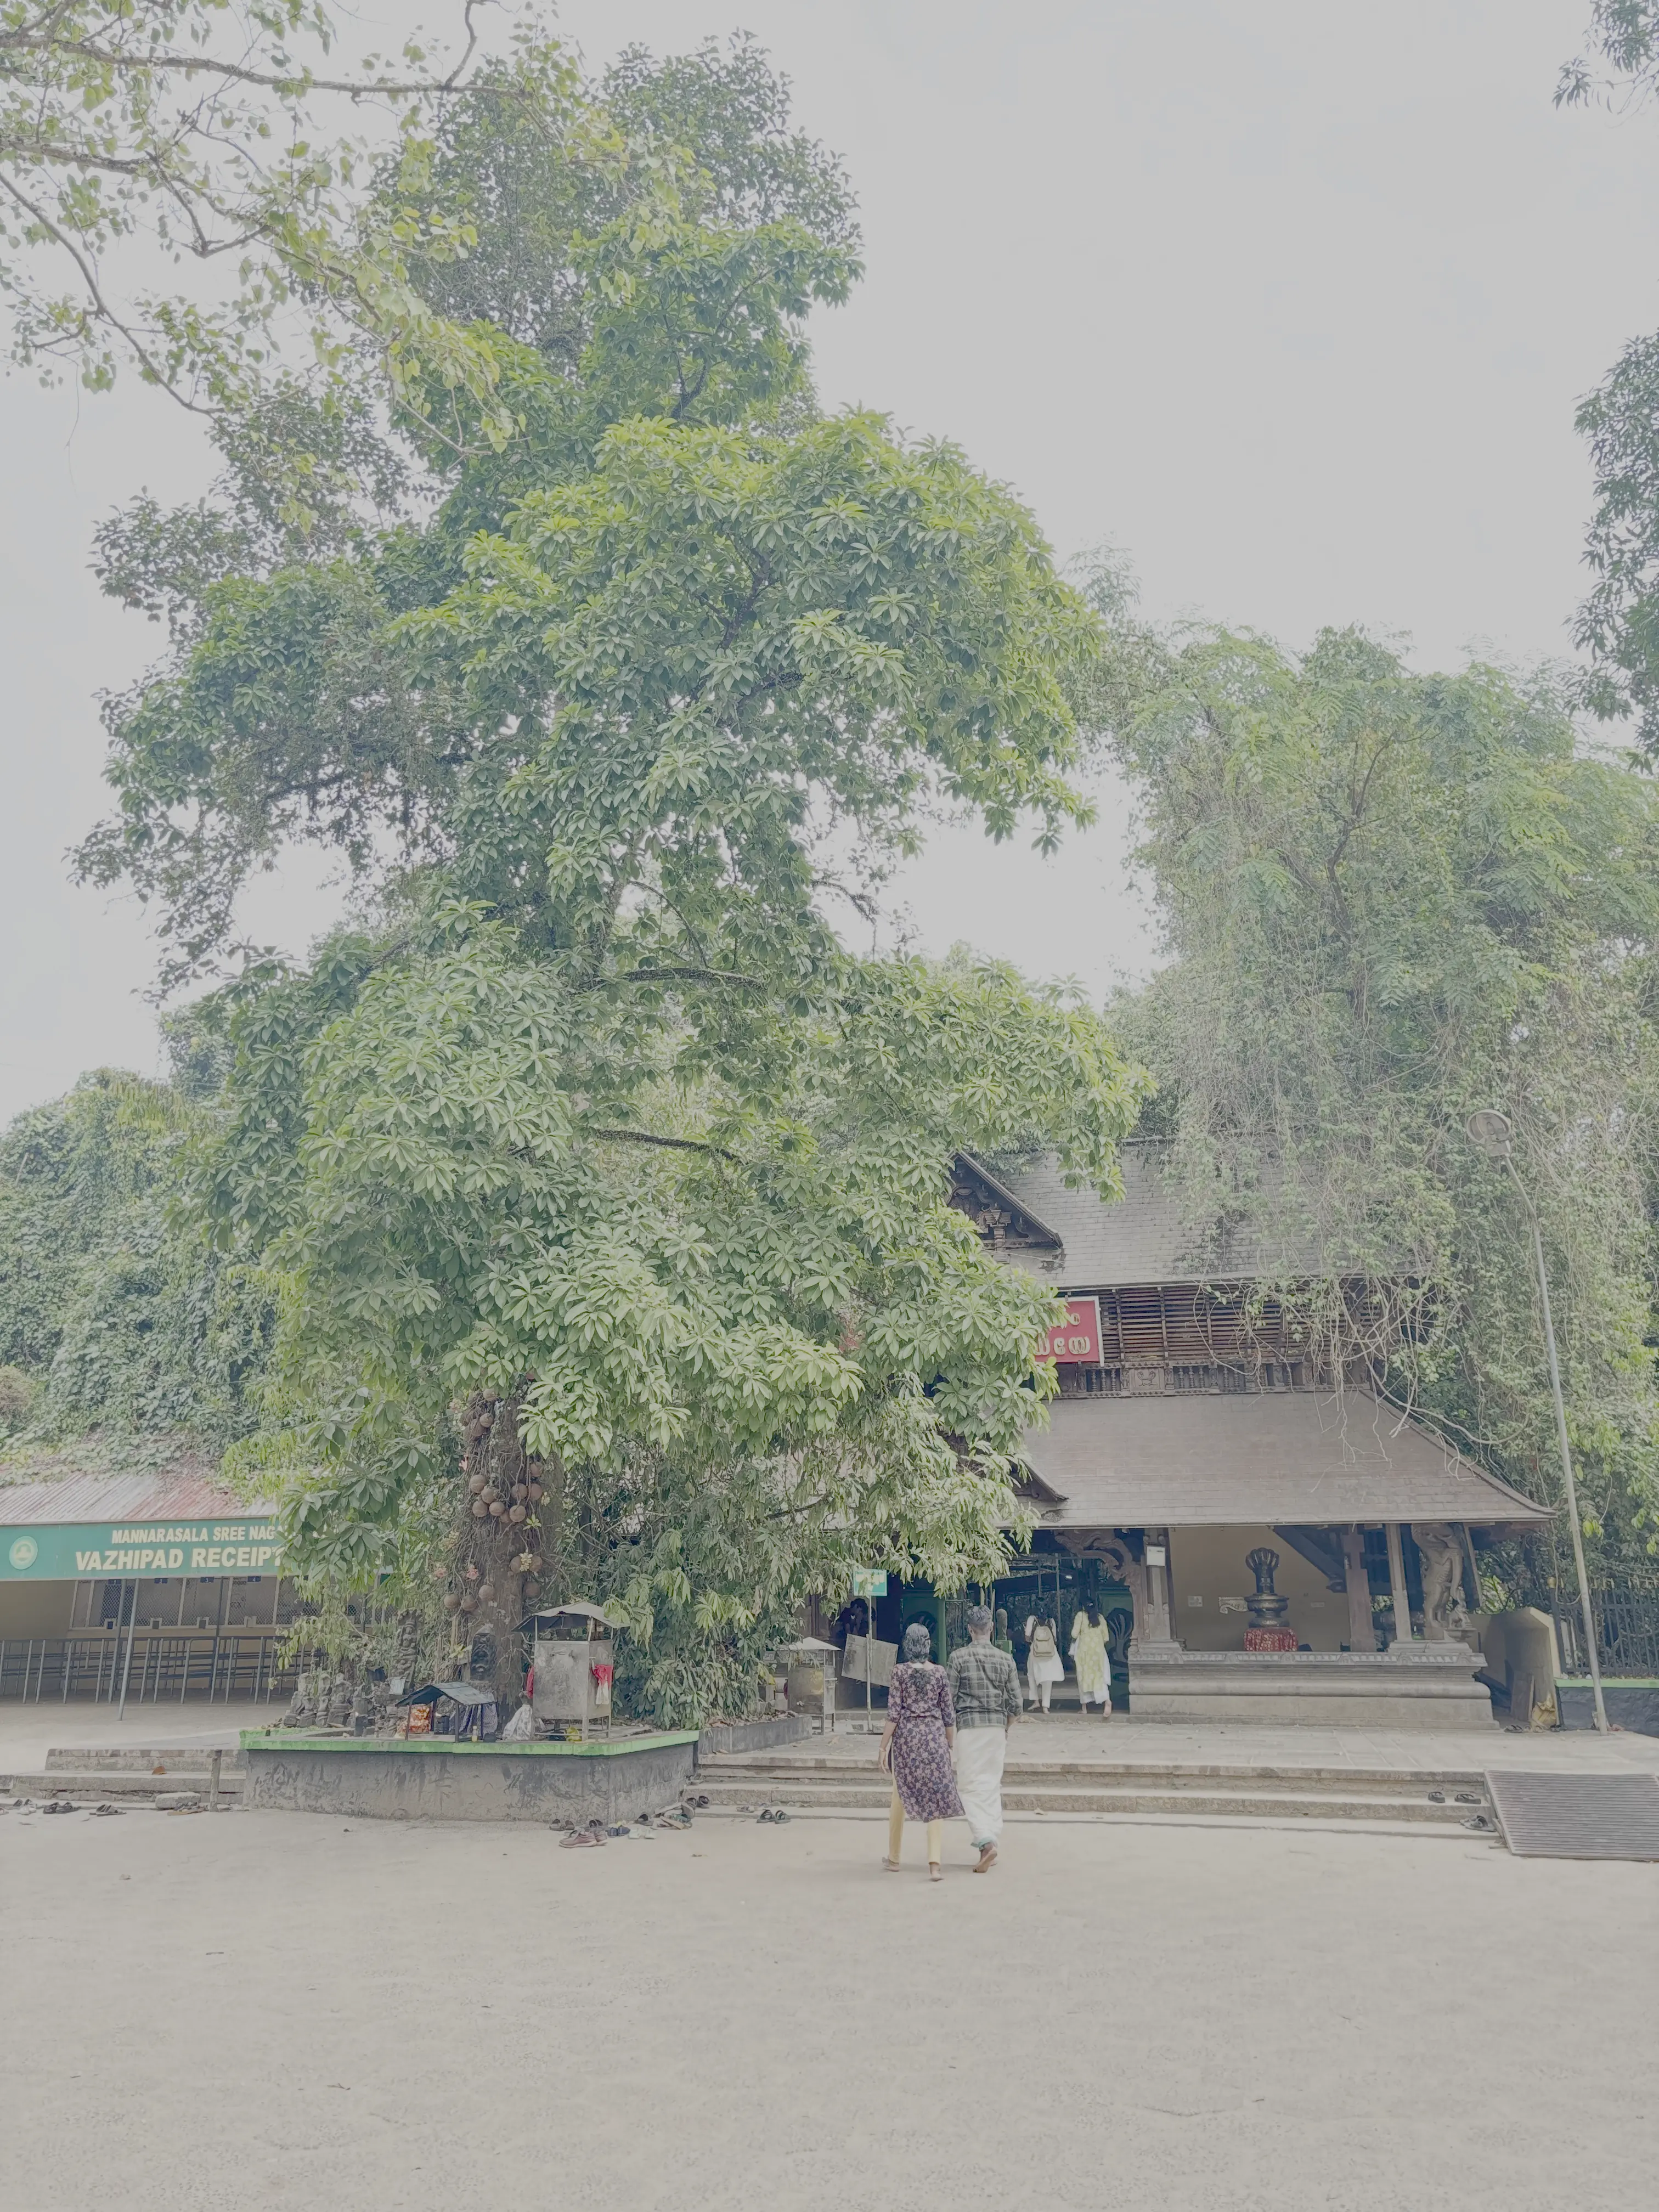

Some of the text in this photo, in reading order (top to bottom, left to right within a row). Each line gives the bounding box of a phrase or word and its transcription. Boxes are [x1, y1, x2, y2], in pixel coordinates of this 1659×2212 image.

[112, 1527, 208, 1544] MANNARASALA
[213, 1526, 245, 1541] SREE
[76, 1549, 183, 1571] VAZHIPAD
